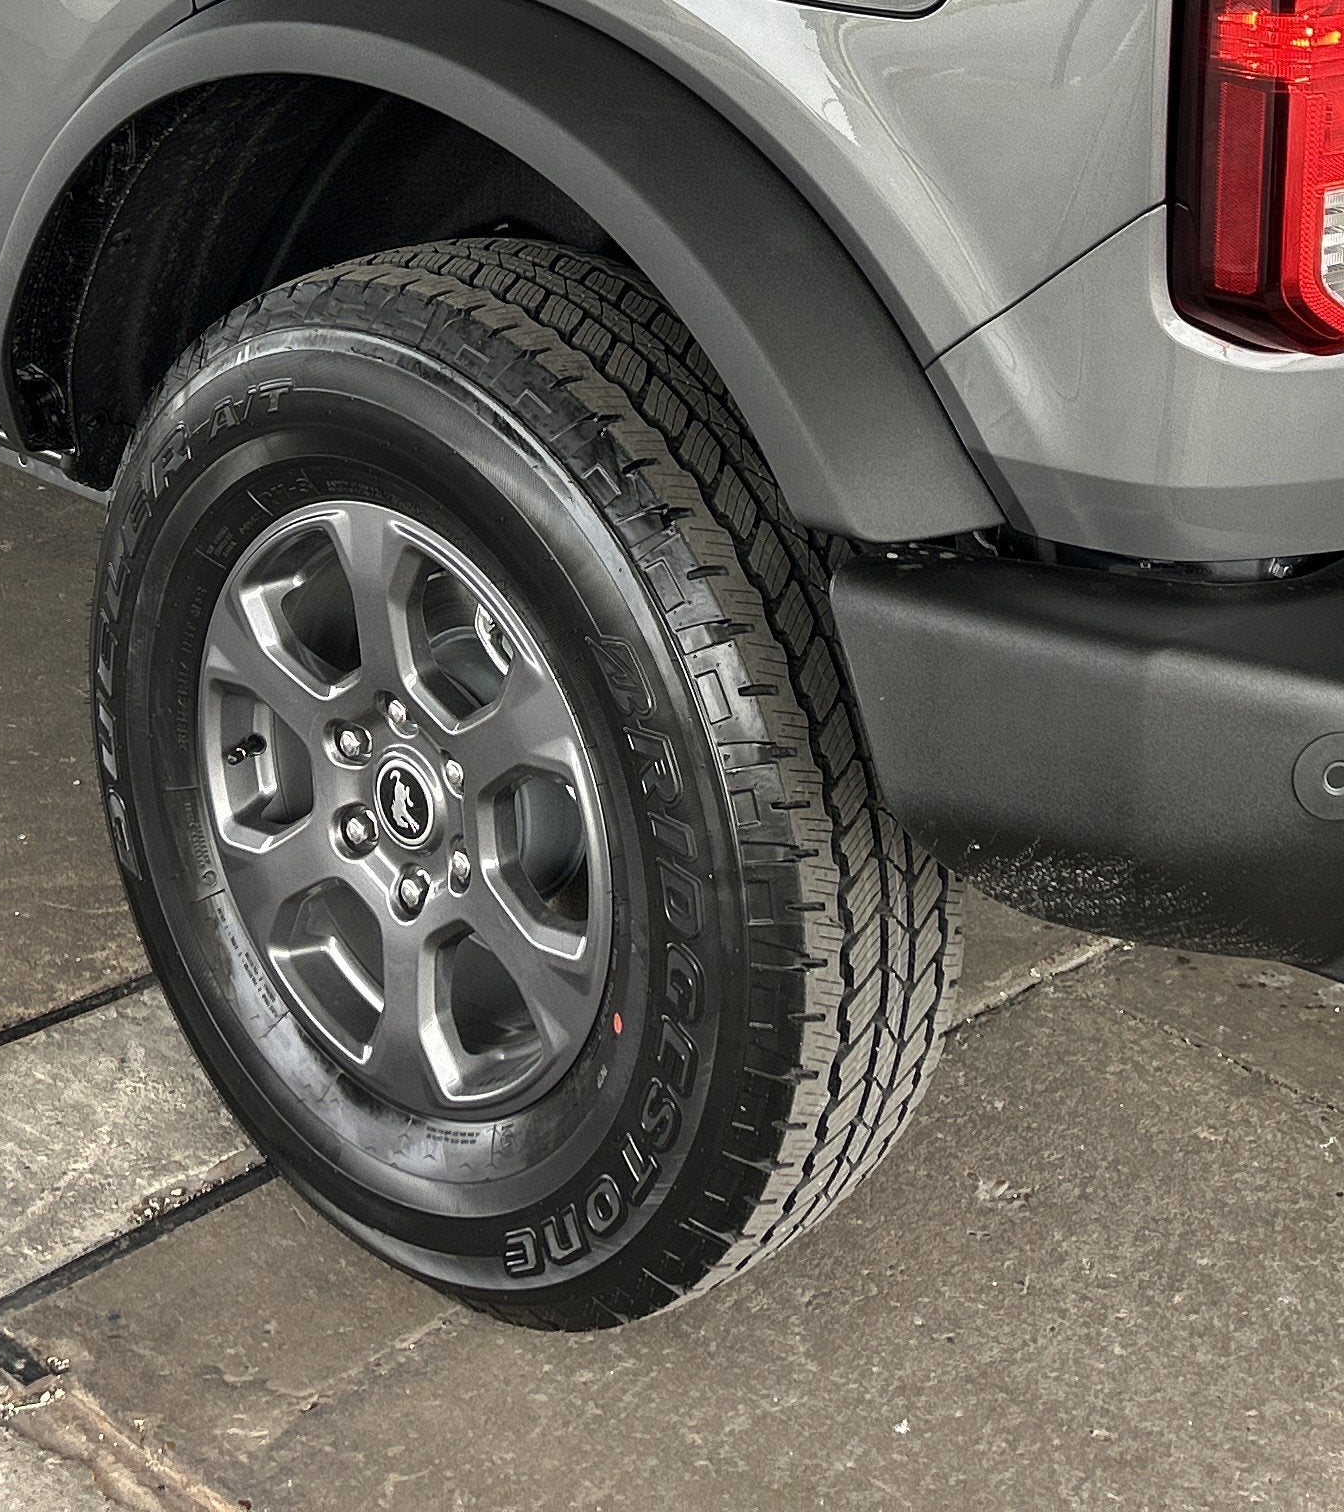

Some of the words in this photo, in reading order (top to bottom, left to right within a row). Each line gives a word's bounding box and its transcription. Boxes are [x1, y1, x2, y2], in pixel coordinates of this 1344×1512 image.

[95, 421, 193, 880] DUELER
[209, 377, 294, 439] A/T
[503, 632, 705, 1279] BRIDGESTONE
